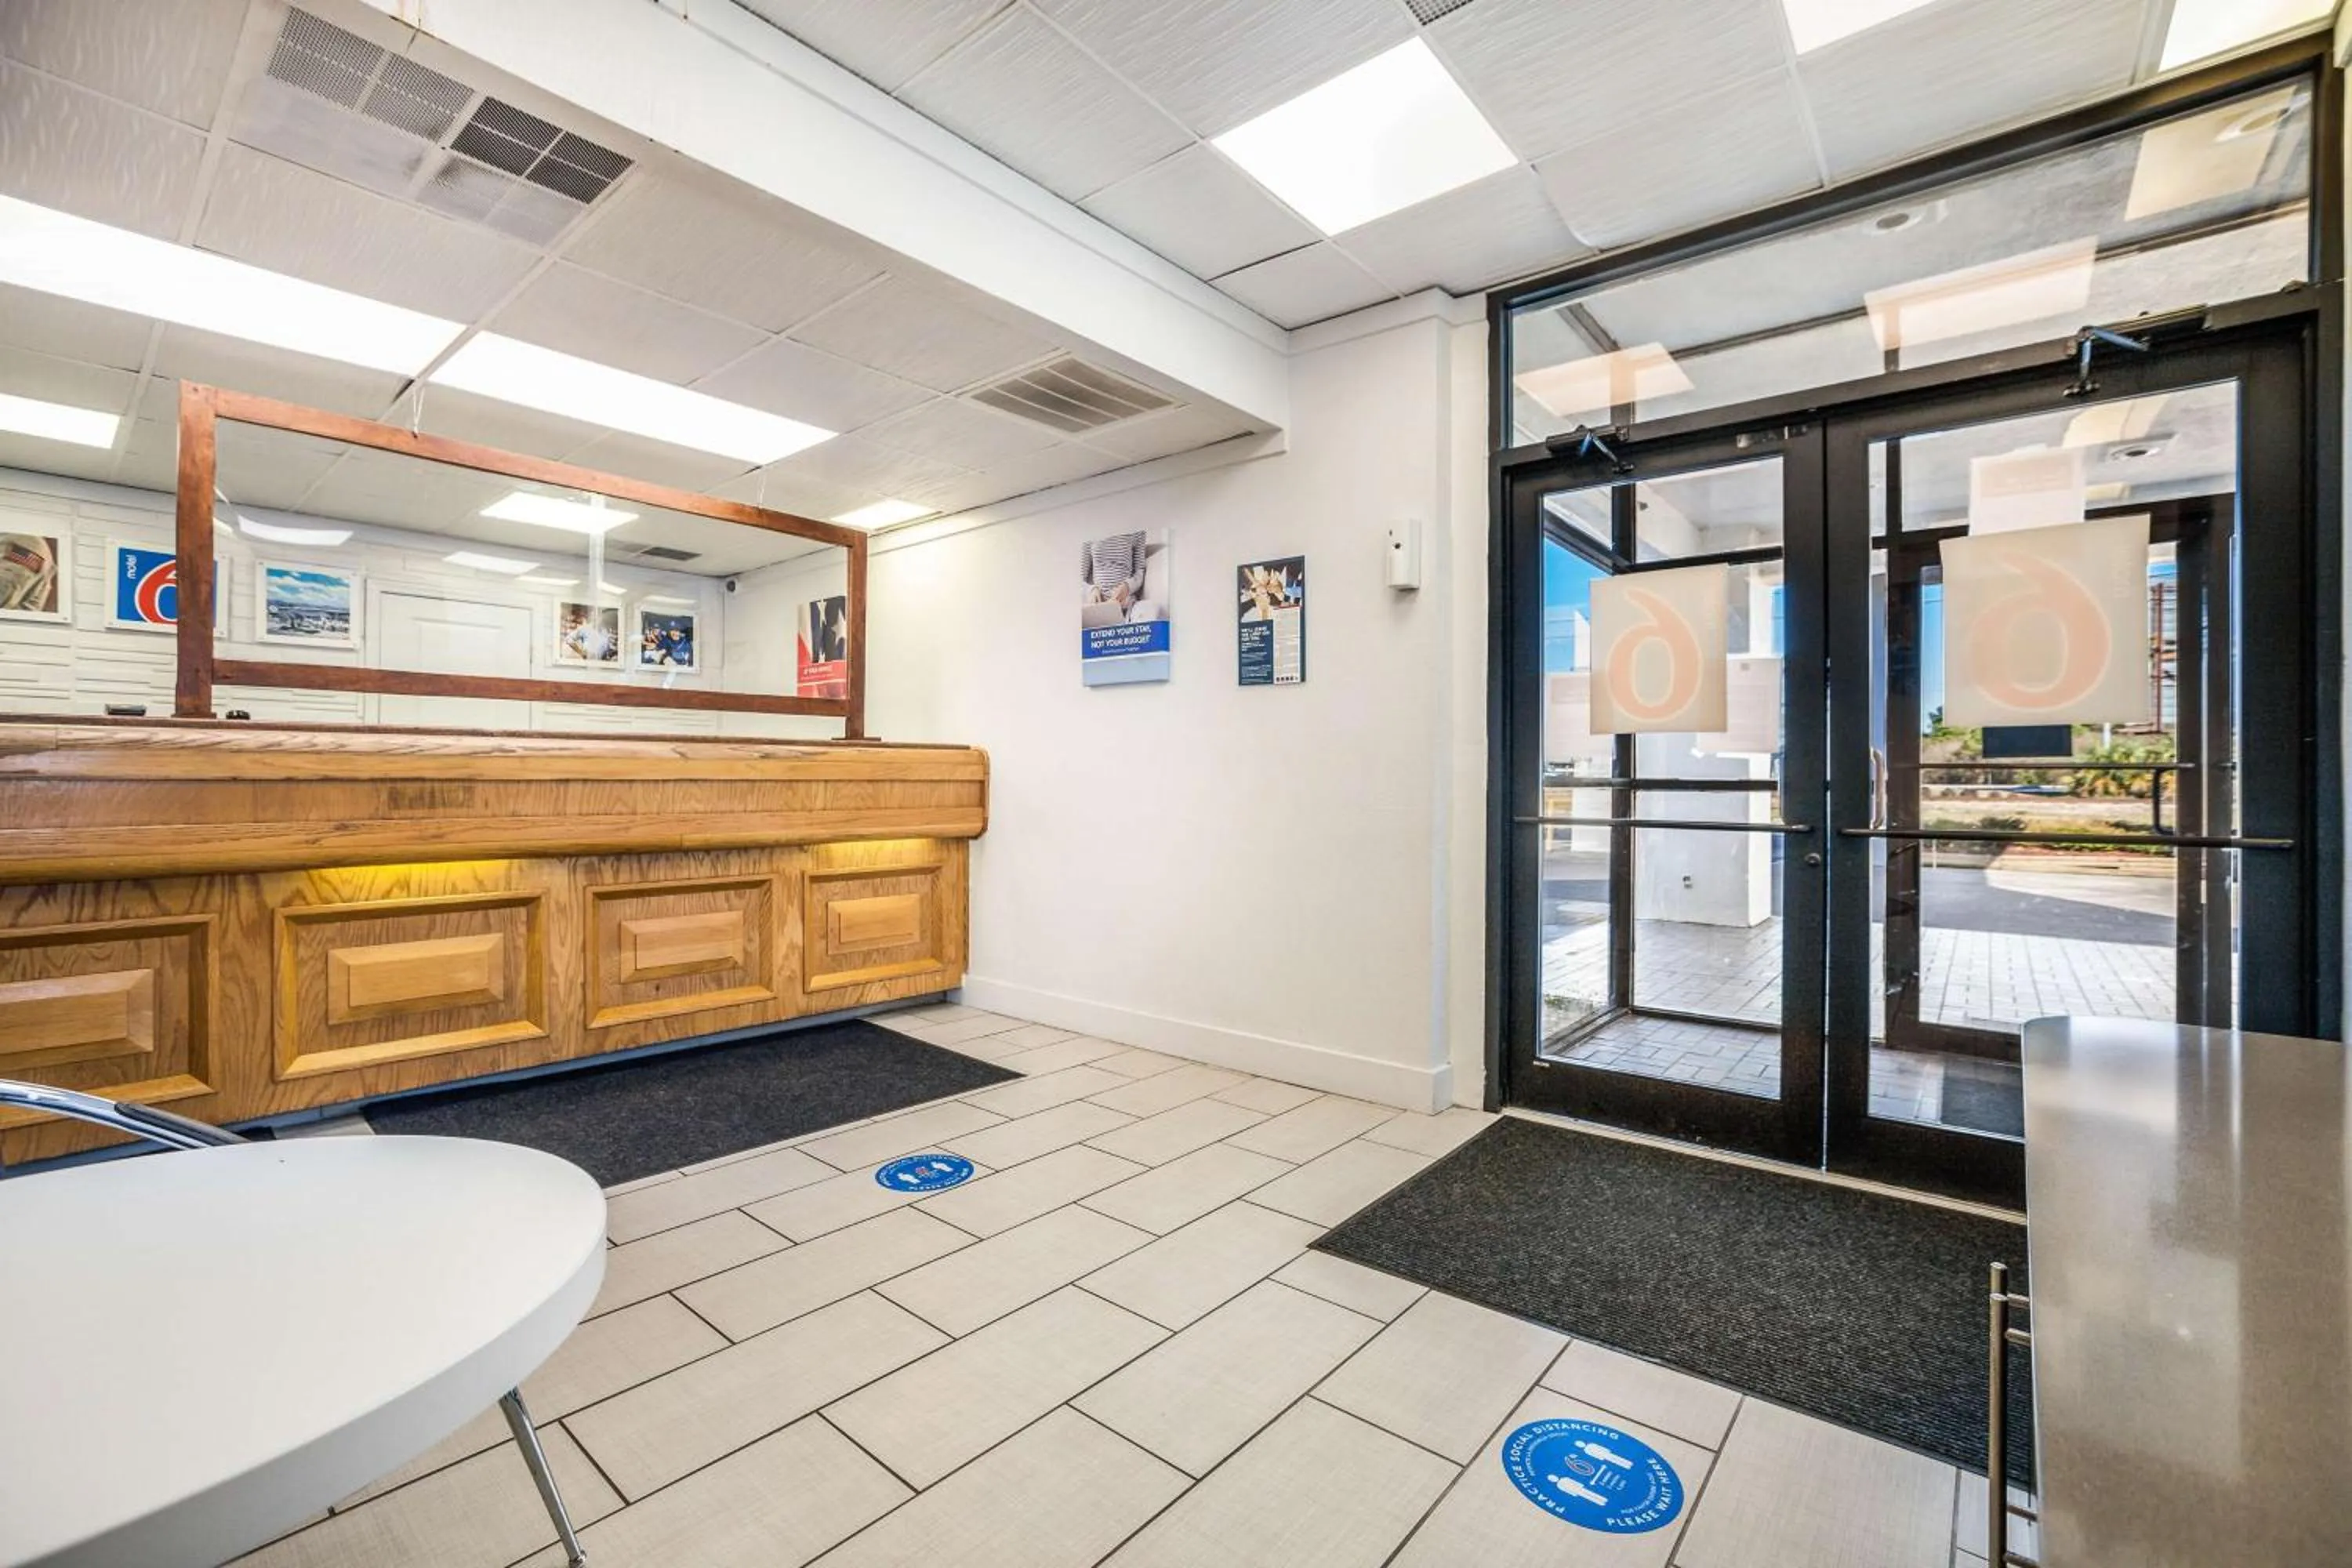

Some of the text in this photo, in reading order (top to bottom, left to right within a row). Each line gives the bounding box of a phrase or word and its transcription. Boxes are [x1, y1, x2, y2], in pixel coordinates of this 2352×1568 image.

[125, 554, 137, 579] motel
[1091, 630, 1115, 639] EXTEND
[1116, 626, 1134, 636] YOUR
[1091, 640, 1105, 649] NOT
[1105, 637, 1123, 647] YOUR
[1531, 1421, 1619, 1441] DISTANCING
[1509, 1432, 1534, 1462] SOCIAL
[1646, 1457, 1671, 1484] HERE
[1512, 1465, 1566, 1514] PRACTICE
[1655, 1486, 1671, 1511] WAIT
[1606, 1508, 1661, 1527] PLEASE
